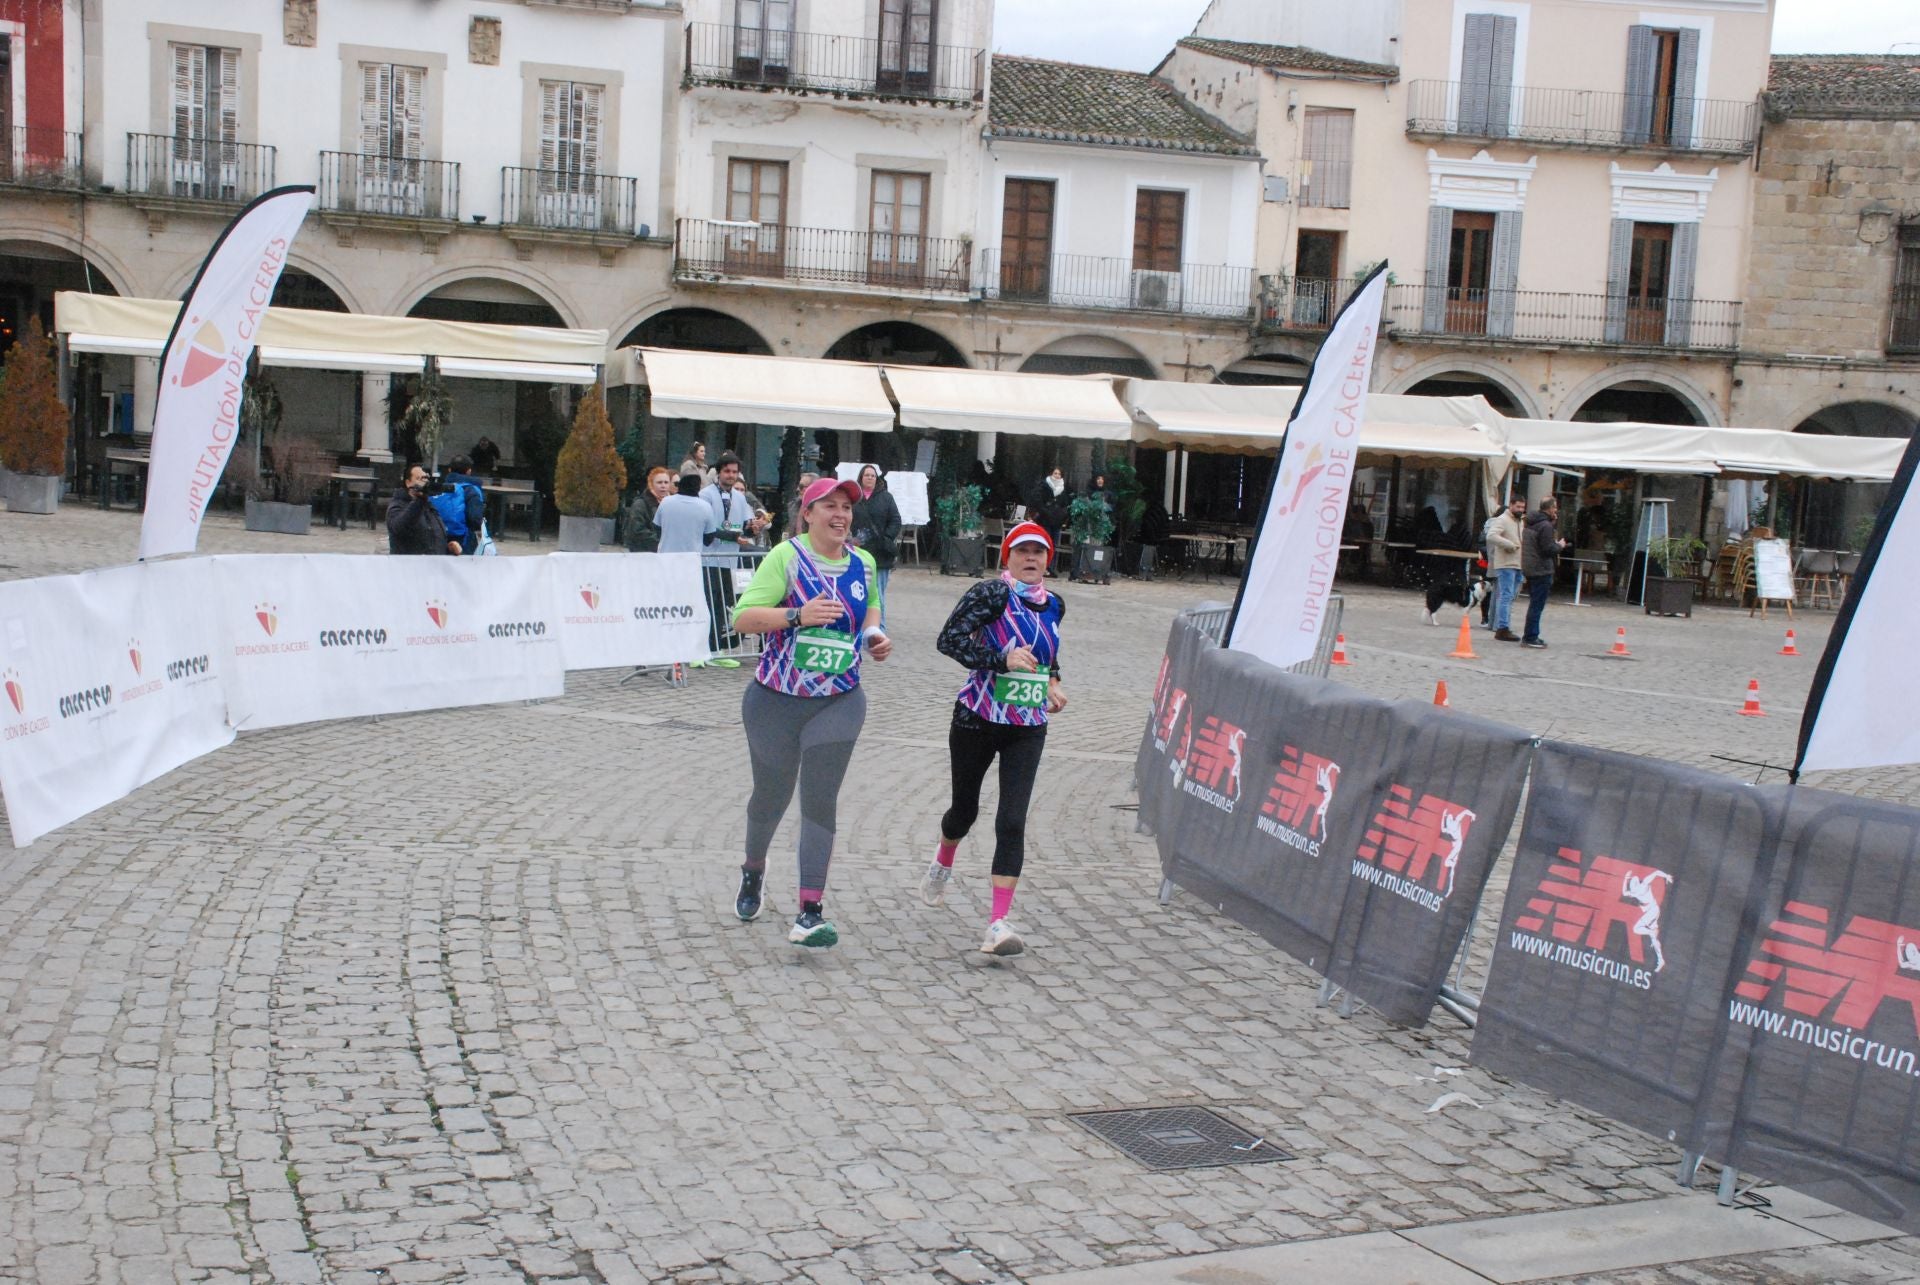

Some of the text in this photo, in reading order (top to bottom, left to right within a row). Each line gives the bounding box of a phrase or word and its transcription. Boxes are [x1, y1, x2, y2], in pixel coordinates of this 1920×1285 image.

[188, 237, 286, 523] DIPUTACIÓN DE CÁCERES
[1299, 325, 1371, 633] DIPUTACIÓN DE CÁCERES
[806, 647, 845, 669] 237
[1005, 680, 1043, 703] 236
[1256, 815, 1320, 858] www.musicrun.es
[1351, 859, 1444, 912] www.musicrun.es
[1511, 931, 1652, 989] www.musicrun.es
